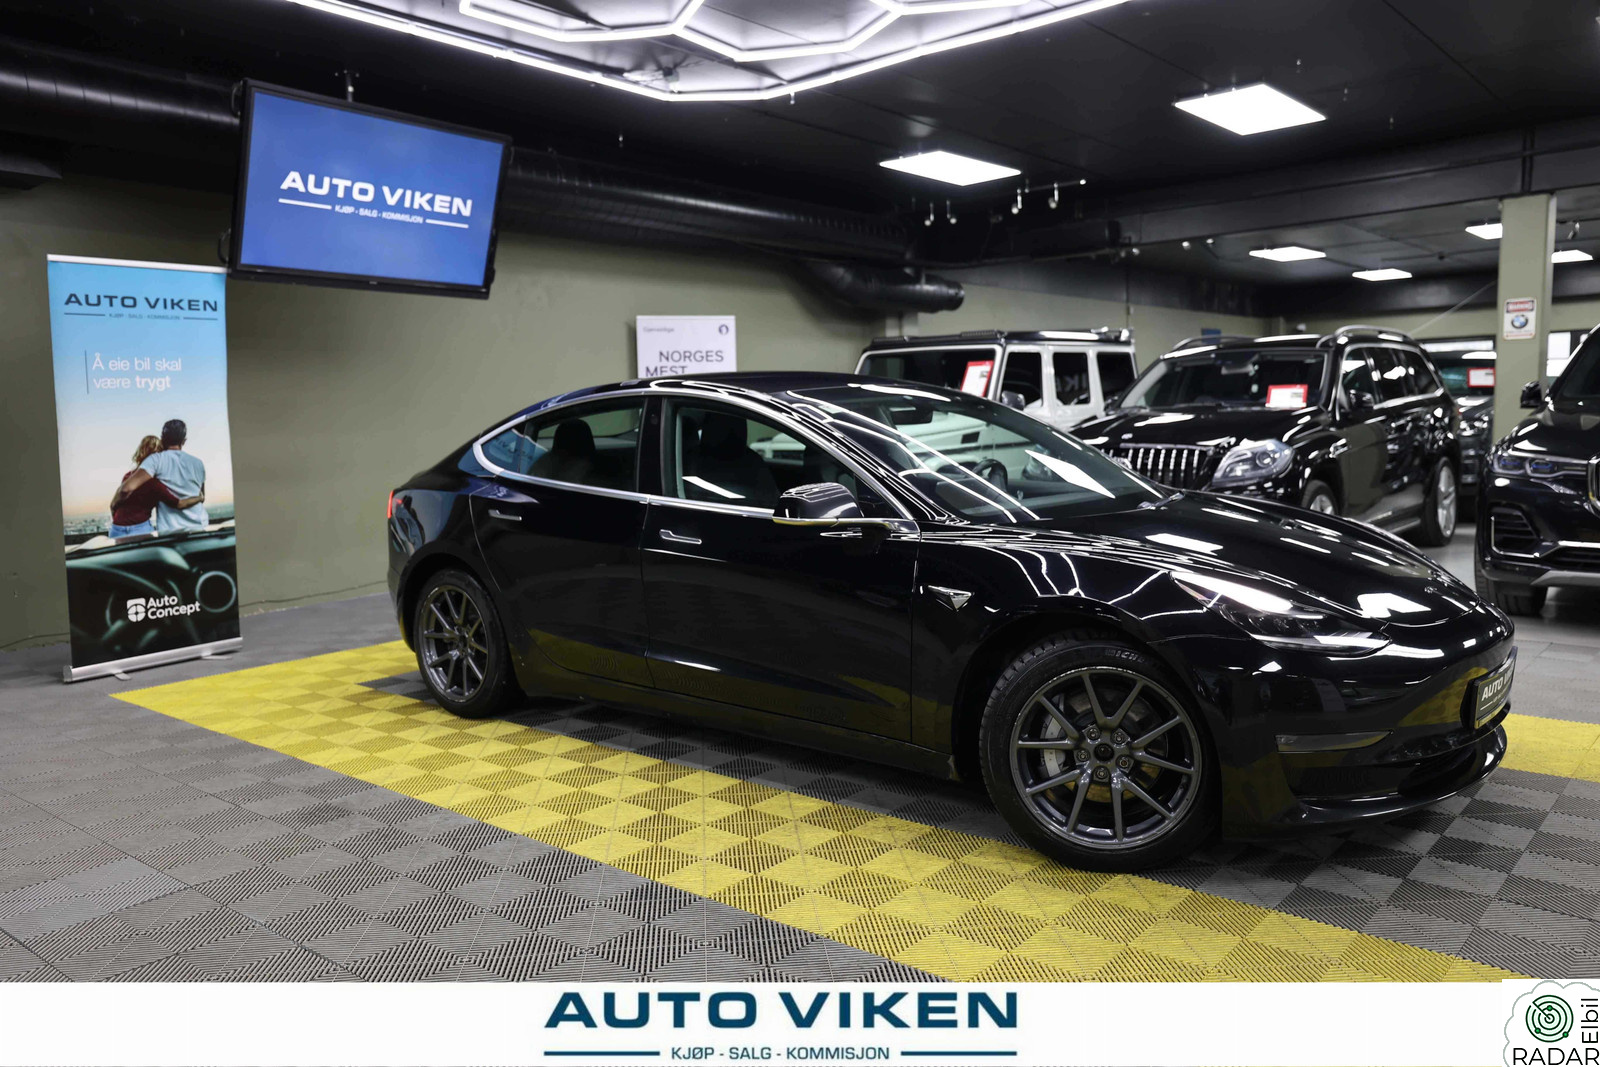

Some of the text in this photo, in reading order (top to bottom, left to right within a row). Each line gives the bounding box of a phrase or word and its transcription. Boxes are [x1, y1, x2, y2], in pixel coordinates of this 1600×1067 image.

[280, 170, 473, 217] AUTO VIKEN
[64, 293, 218, 312] AUTO VIKEN
[92, 353, 182, 372] Å eie bil skal
[659, 350, 724, 363] NORGES
[93, 375, 171, 391] være trygt
[147, 594, 178, 609] Auto
[147, 601, 201, 619] Concept
[1481, 677, 1503, 701] AUTO
